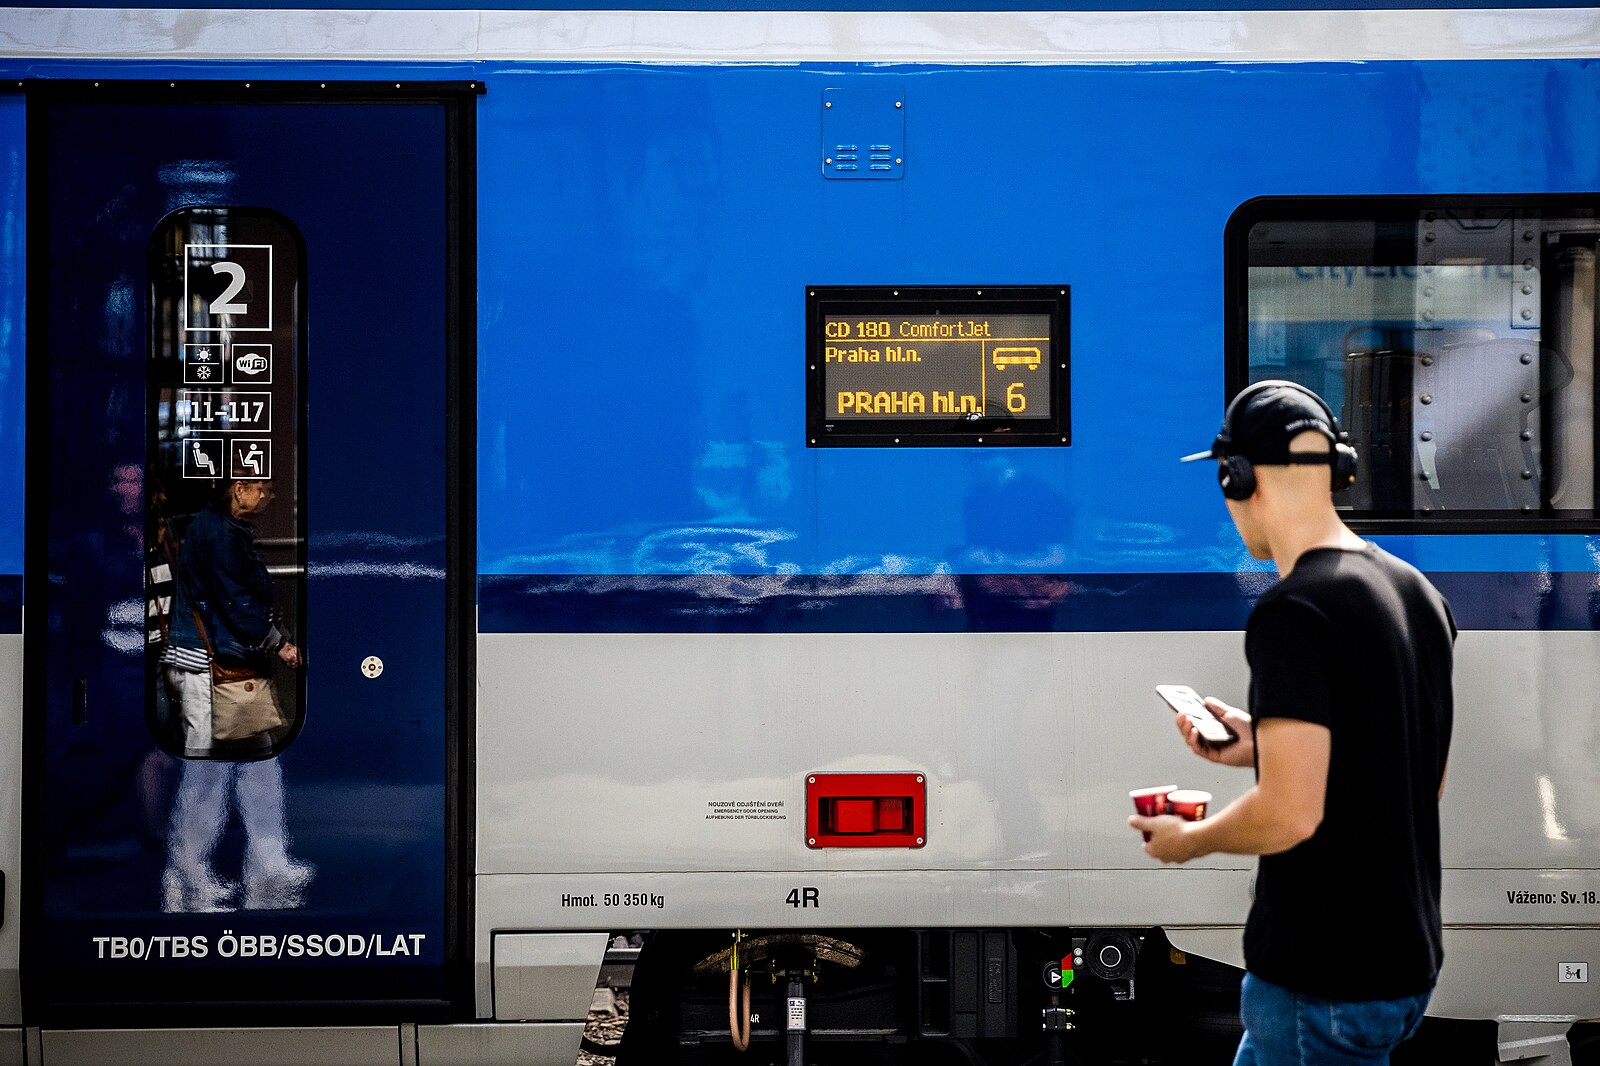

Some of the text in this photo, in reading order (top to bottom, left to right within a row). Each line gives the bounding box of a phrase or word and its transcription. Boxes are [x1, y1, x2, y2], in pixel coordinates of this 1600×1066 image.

[209, 261, 248, 315] 2
[824, 320, 992, 339] CD 180 ComfortJet
[825, 346, 922, 363] Praha hl.n.
[837, 390, 983, 414] PRAHA hl.n.
[1006, 382, 1027, 413] 6
[190, 401, 265, 423] 11-117
[561, 892, 665, 909] Hmot. 50 350 kg
[785, 887, 820, 908] 4R
[1506, 890, 1557, 905] Váženo:
